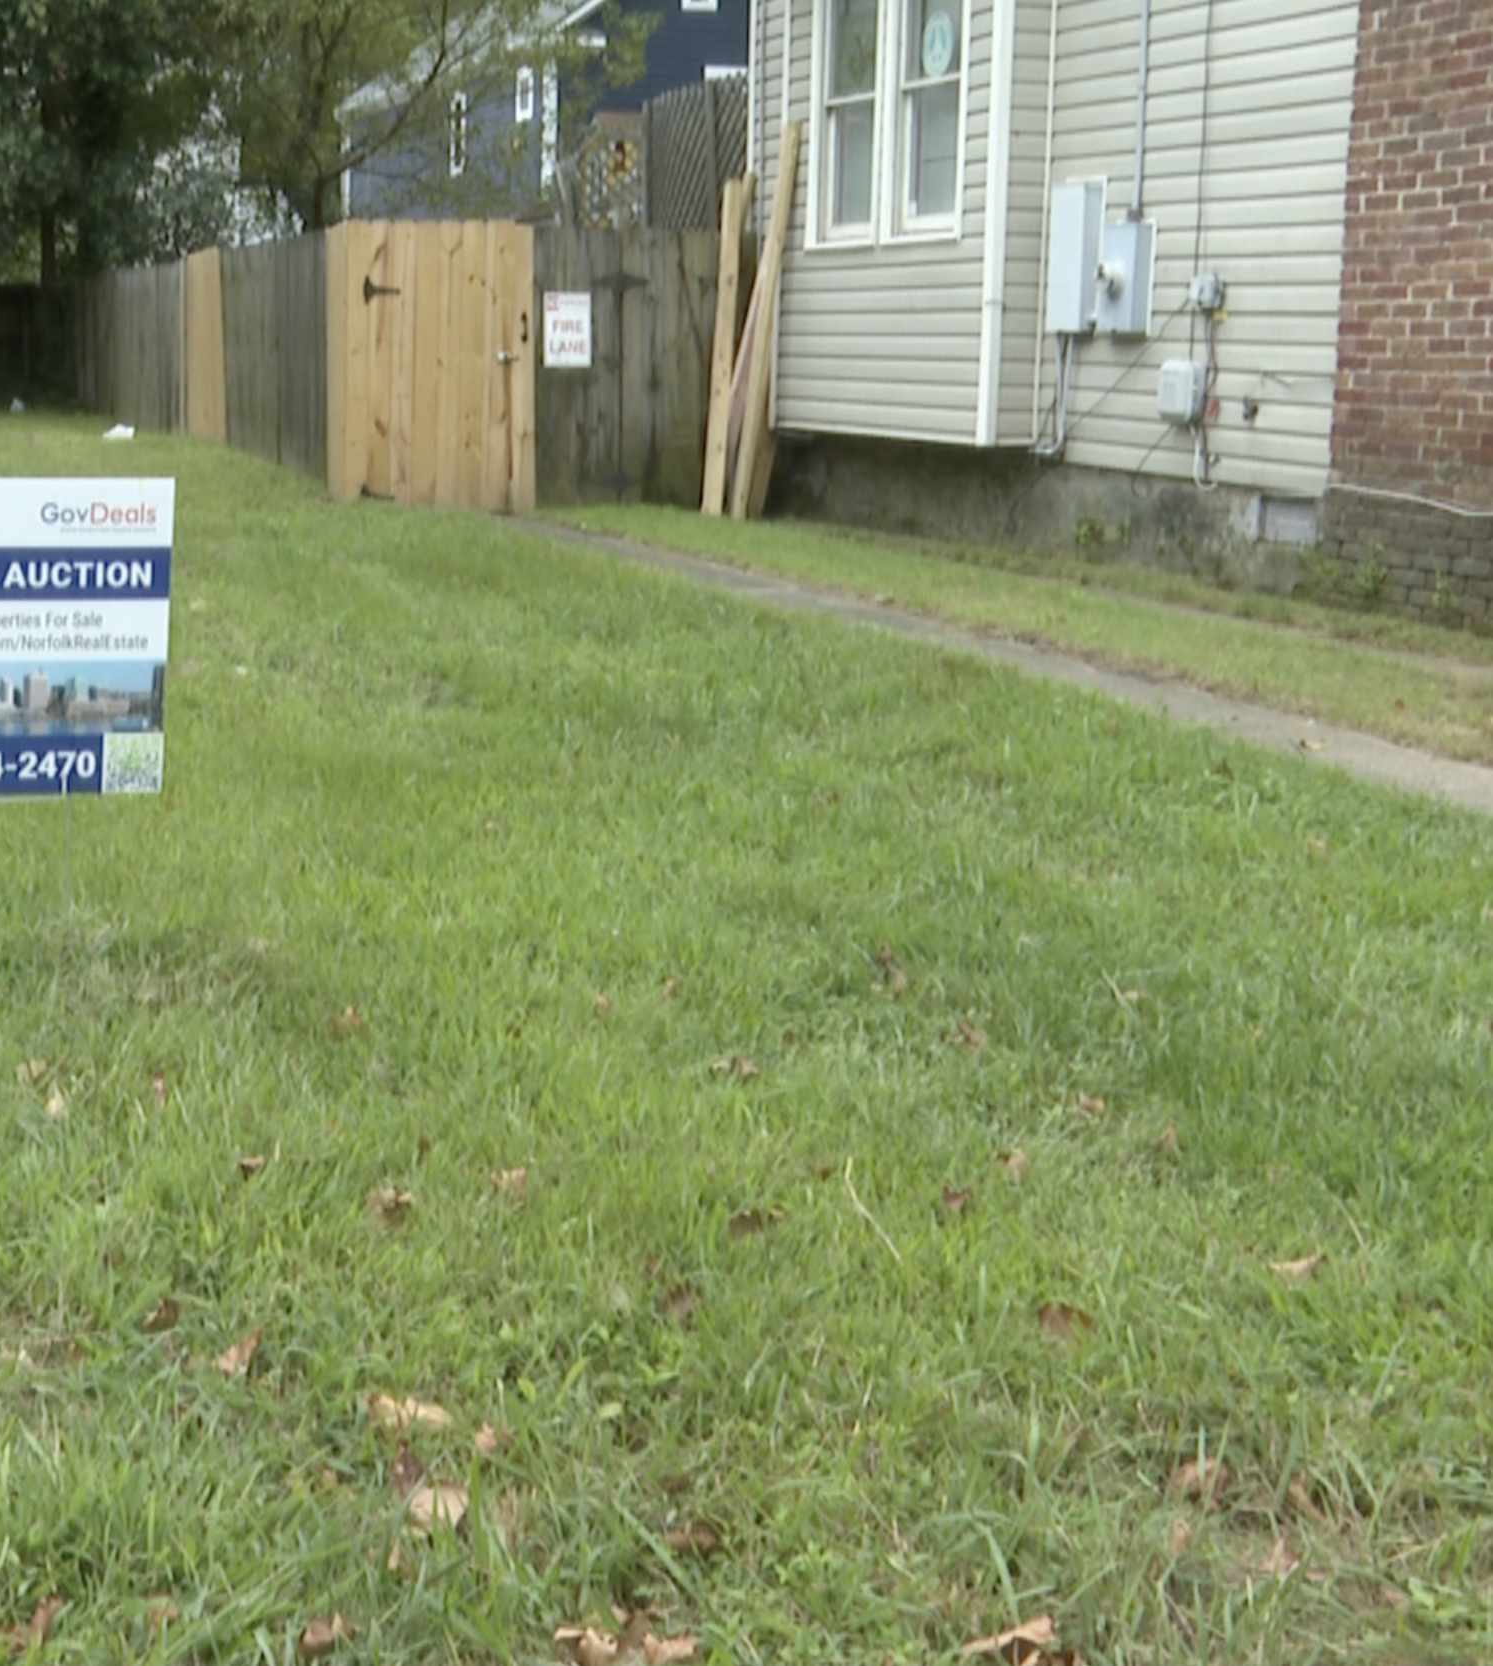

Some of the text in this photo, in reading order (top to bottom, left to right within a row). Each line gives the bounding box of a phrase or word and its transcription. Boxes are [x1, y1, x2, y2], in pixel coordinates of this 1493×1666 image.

[552, 320, 584, 333] FIRE
[549, 341, 586, 355] LANE
[40, 502, 156, 525] GovDeals
[3, 561, 153, 588] AUCTION
[45, 612, 69, 628] For
[72, 612, 103, 629] Sale
